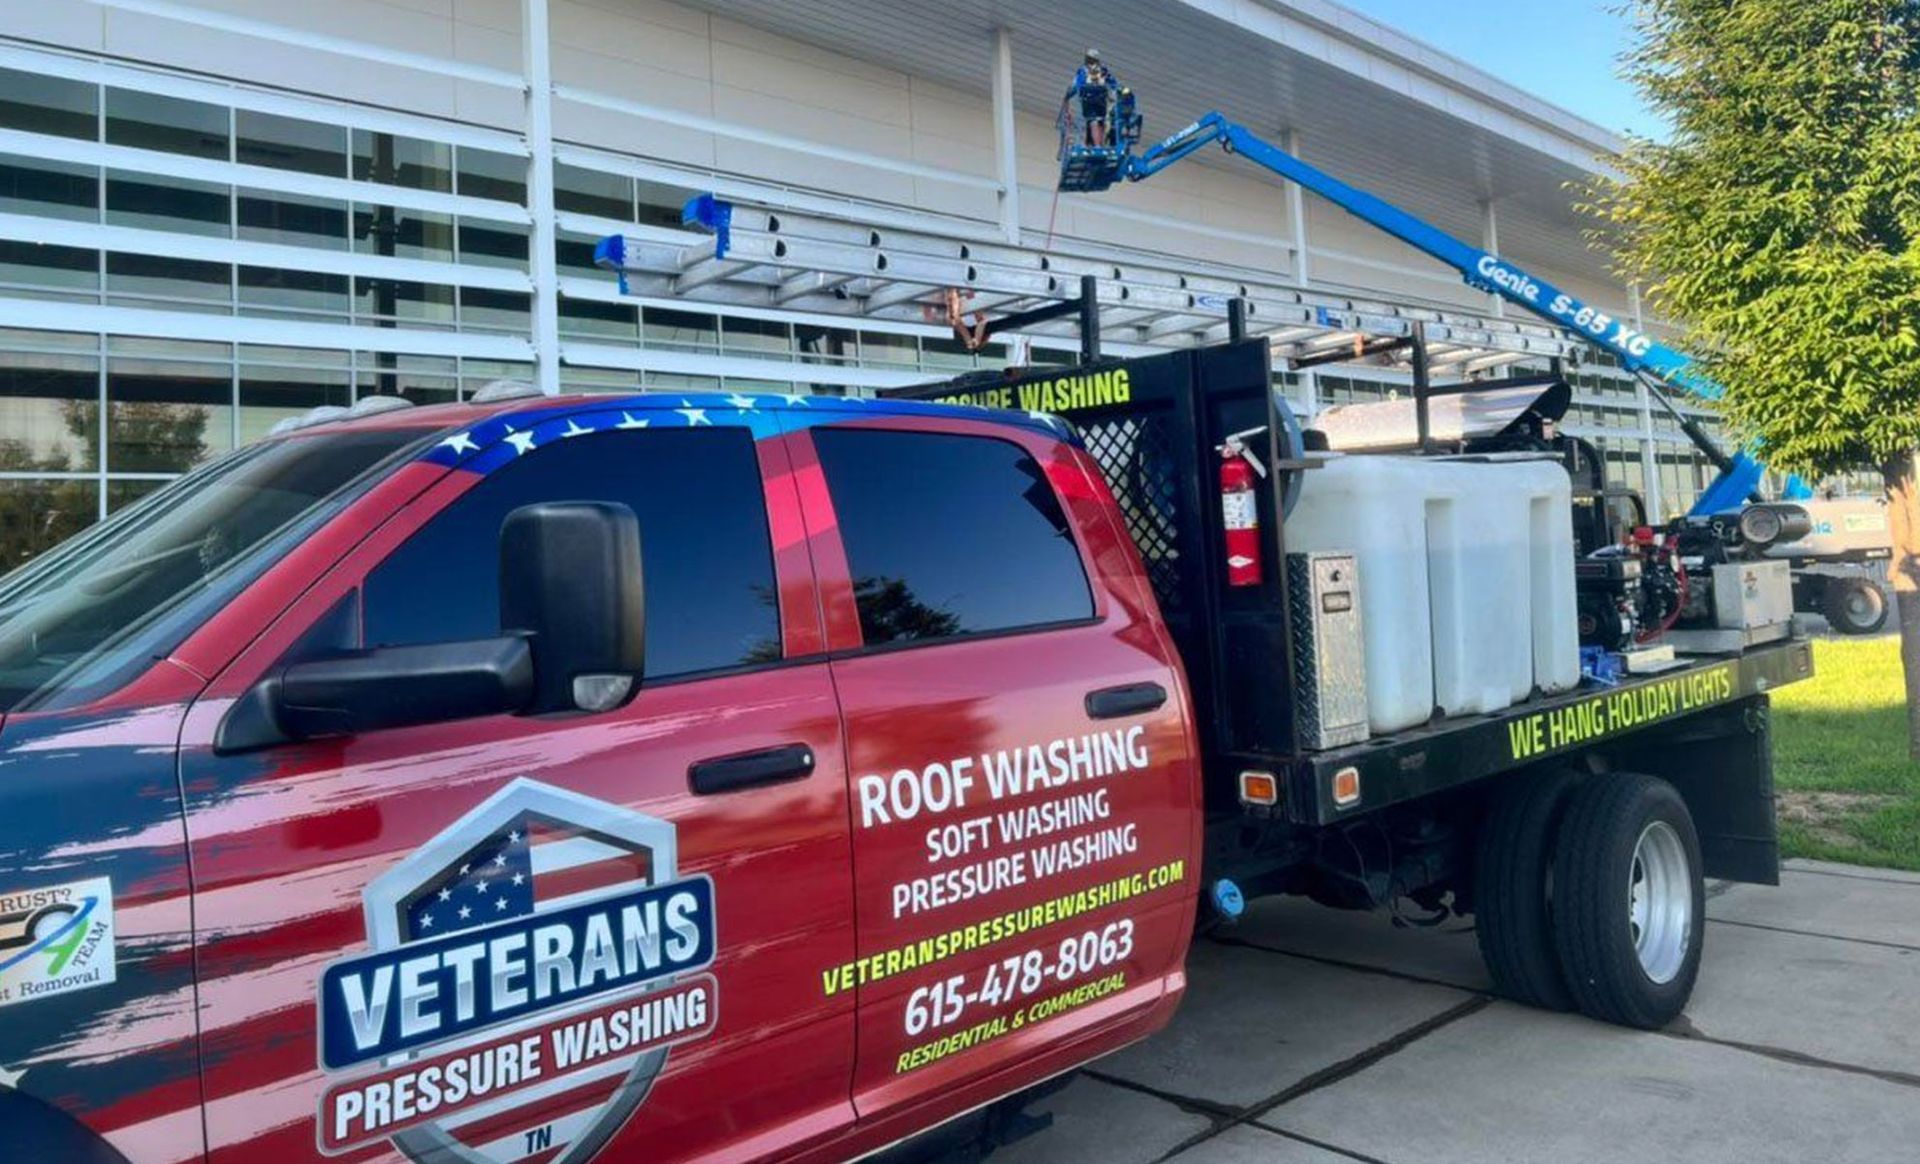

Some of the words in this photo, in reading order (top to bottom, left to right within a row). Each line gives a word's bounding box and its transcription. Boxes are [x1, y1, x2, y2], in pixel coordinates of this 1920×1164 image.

[1478, 256, 1540, 302] Genie
[1550, 295, 1612, 334] S-65
[1609, 321, 1651, 356] XC
[1018, 368, 1130, 412] WASHING
[1509, 715, 1546, 760] WE
[1549, 700, 1605, 748] HANG
[1607, 680, 1678, 731] HOLIDAY
[1680, 667, 1731, 709] LIGHTS
[858, 756, 974, 828] ROOF
[982, 725, 1148, 800] WASHING
[926, 817, 992, 862] SOFT
[998, 788, 1110, 843] WASHING
[893, 853, 1026, 918] PRESSURE
[1032, 823, 1137, 880] WASHING
[72, 921, 109, 966] TEAM
[340, 890, 700, 1052] VETERANS
[822, 860, 1184, 996] VETERANSPRESSUREWASHING.COM
[20, 967, 100, 997] Removal
[896, 1012, 1008, 1074] RESIDENTIAL
[1012, 1009, 1024, 1029] &
[1029, 972, 1126, 1023] COMMERCIAL
[904, 918, 1134, 1036] 615-478-8063
[335, 1035, 541, 1140] PRESSURE
[551, 987, 707, 1069] WASHING
[525, 1125, 552, 1155] TN
